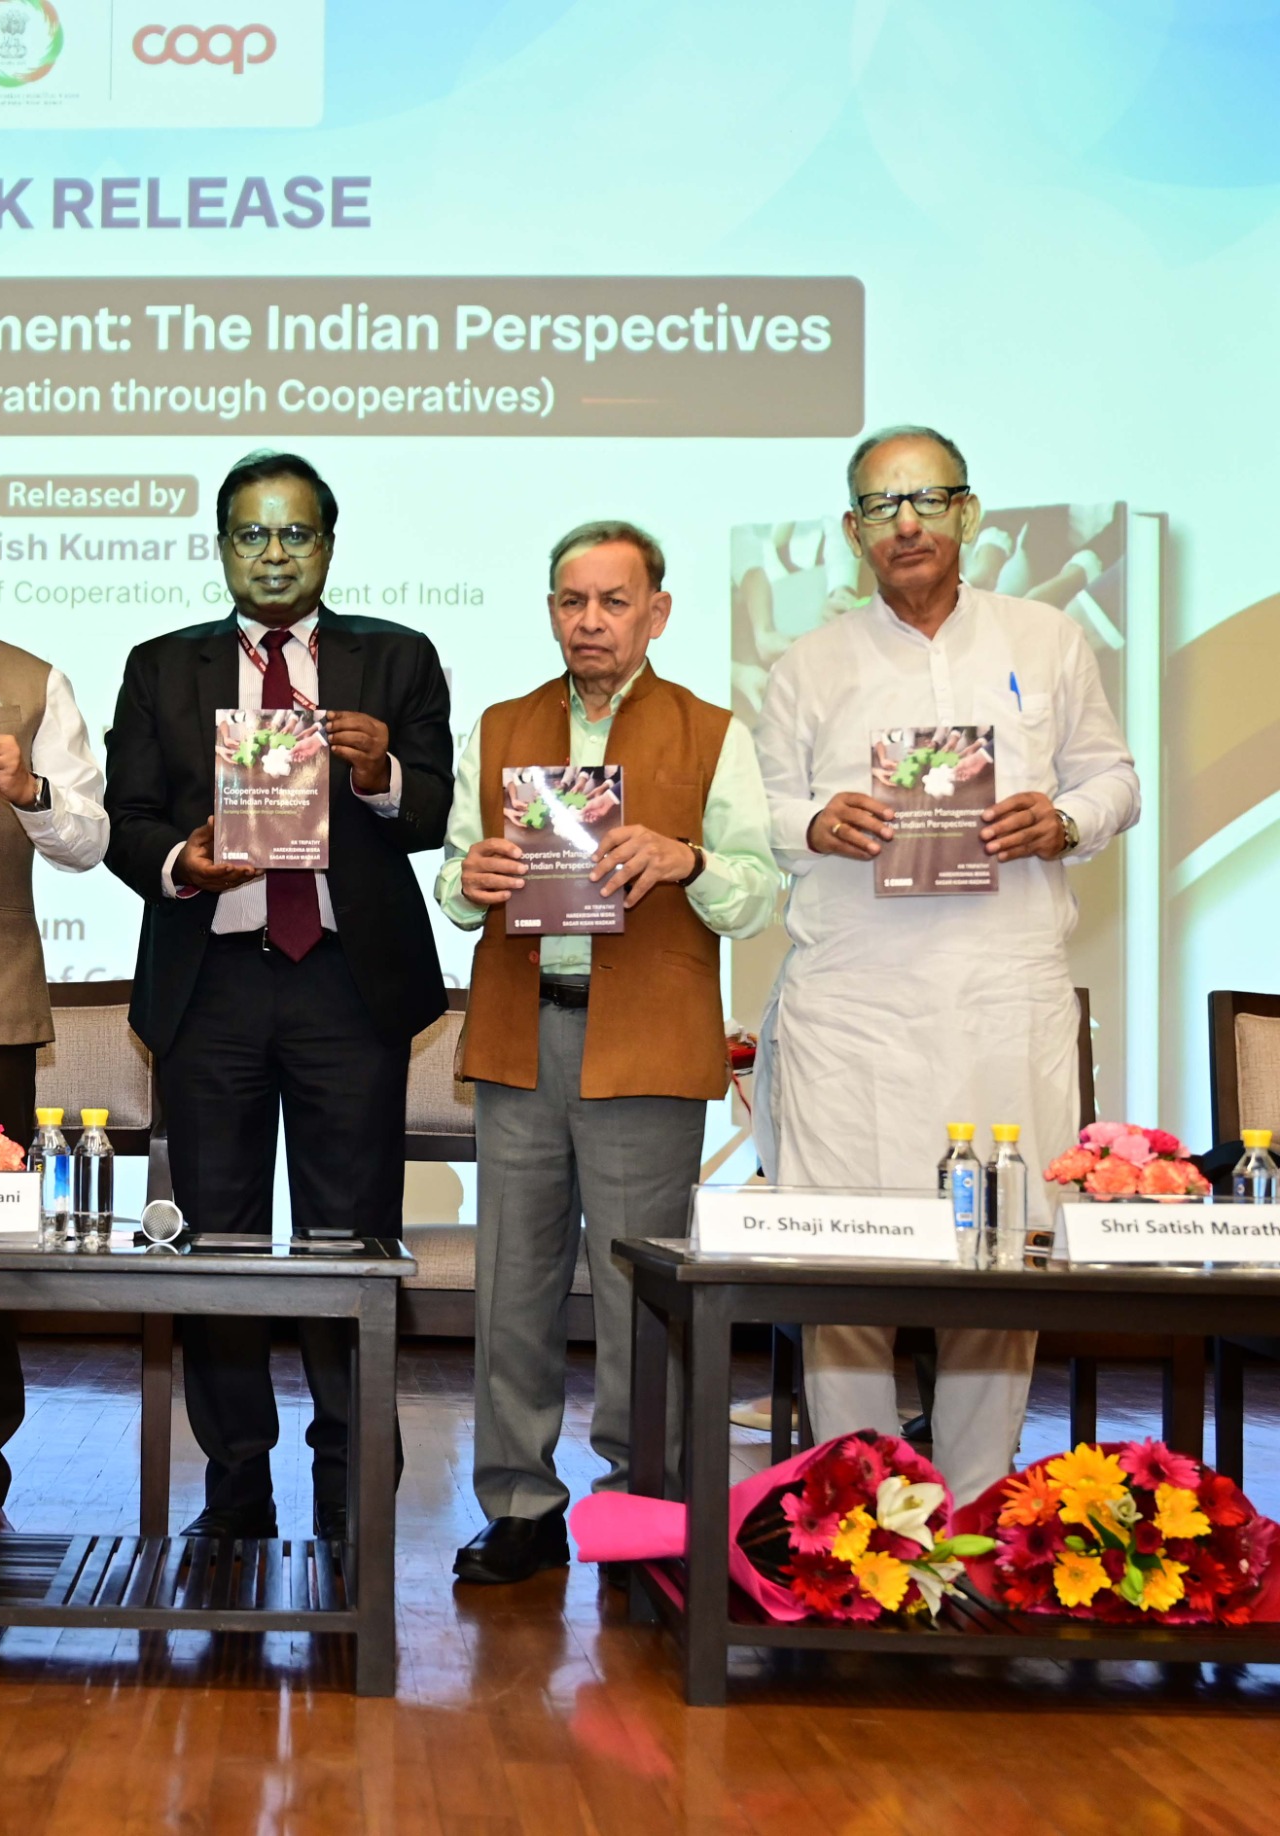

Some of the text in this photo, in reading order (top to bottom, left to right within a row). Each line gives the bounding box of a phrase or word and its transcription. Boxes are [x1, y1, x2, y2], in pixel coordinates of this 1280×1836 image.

[132, 22, 277, 74] coop
[53, 175, 371, 229] RELEASE
[147, 305, 251, 351] The
[269, 302, 438, 351] Indian
[456, 302, 831, 361] Perspectives
[111, 378, 266, 419] through
[279, 377, 554, 418] Cooperatives)
[8, 481, 185, 513] Released by
[61, 533, 177, 561] Kumar
[14, 581, 190, 609] Cooperation,
[392, 581, 410, 605] of
[419, 582, 484, 606] India
[224, 787, 318, 797] Cooperative Management
[224, 797, 310, 808] The Indian Perspectives
[895, 808, 985, 819] operative Managemen
[901, 821, 925, 829] Indian
[927, 820, 976, 830] Perspectives
[521, 851, 560, 861] ooperative
[531, 862, 553, 870] Indian
[743, 1216, 914, 1237] Dr. Shaji Krishnan
[1101, 1219, 1280, 1236] Shri Satish Marath
